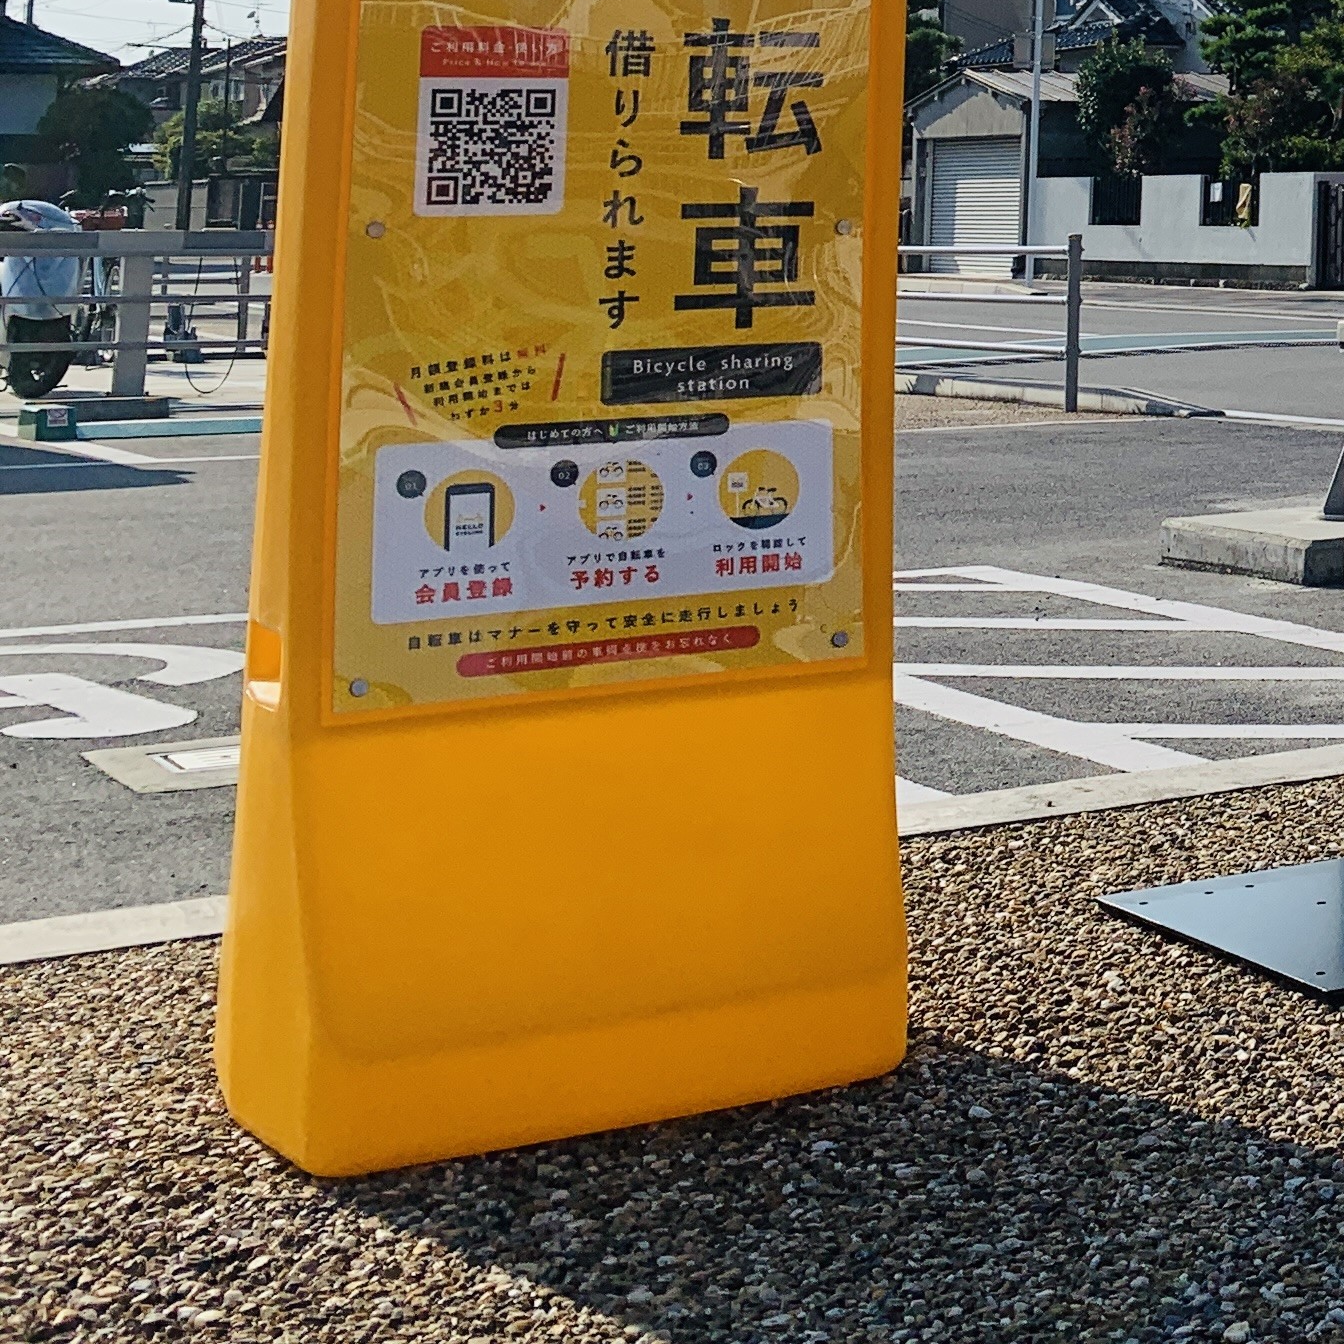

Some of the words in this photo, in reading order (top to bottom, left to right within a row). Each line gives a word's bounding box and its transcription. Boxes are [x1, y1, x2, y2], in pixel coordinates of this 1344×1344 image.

[598, 27, 657, 331] 借りられます
[632, 355, 708, 377] Bicycle
[720, 352, 794, 372] sharing
[676, 375, 751, 394] station
[526, 425, 604, 442] はじめての方へ
[557, 471, 571, 481] 02
[566, 548, 666, 566] アプリで自転車を
[715, 551, 804, 577] 利用開始
[418, 561, 511, 579] アプリを使って
[570, 564, 661, 591] 予約する
[414, 577, 514, 605] 会員登録
[407, 598, 799, 651] 自転車はマナーを守って安全に走行しましょう
